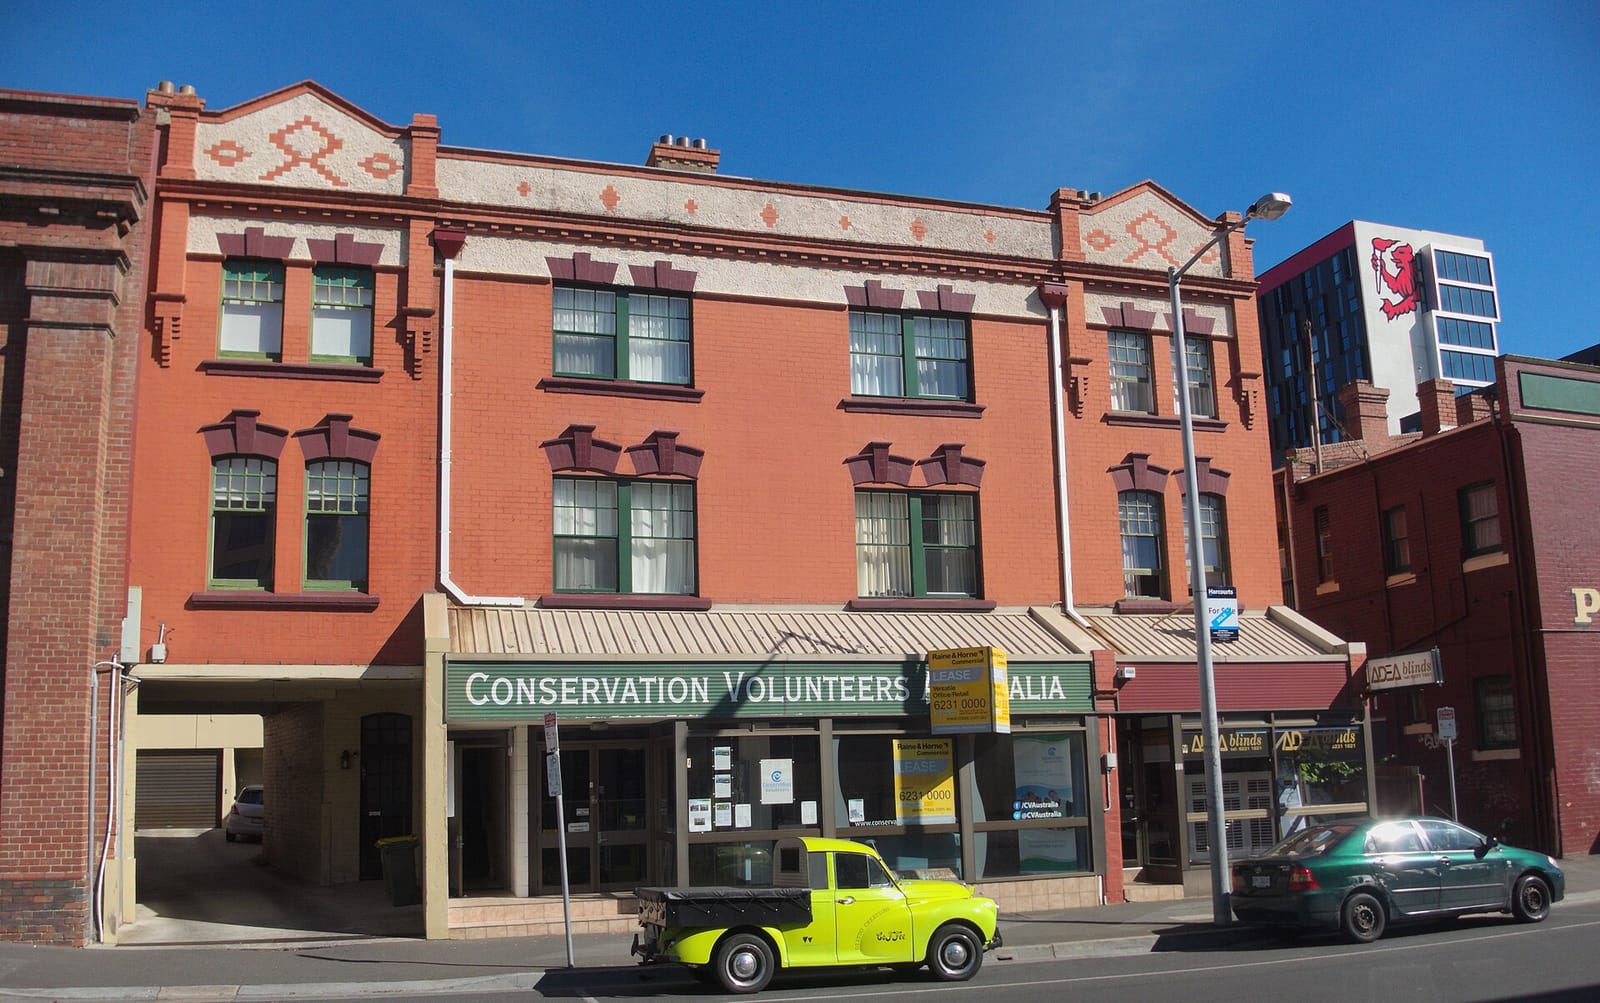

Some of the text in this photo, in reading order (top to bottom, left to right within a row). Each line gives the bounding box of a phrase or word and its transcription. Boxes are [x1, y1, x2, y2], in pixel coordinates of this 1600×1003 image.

[932, 669, 971, 682] LEASE
[1371, 658, 1432, 683] ADEA blinds
[465, 672, 710, 706] CONSERVATION
[722, 671, 910, 703] VOLUNTEERS
[934, 698, 986, 710] 6231 0000
[1229, 732, 1262, 747] blinds
[897, 760, 937, 773] LEASE
[899, 790, 951, 801] 6231 0000
